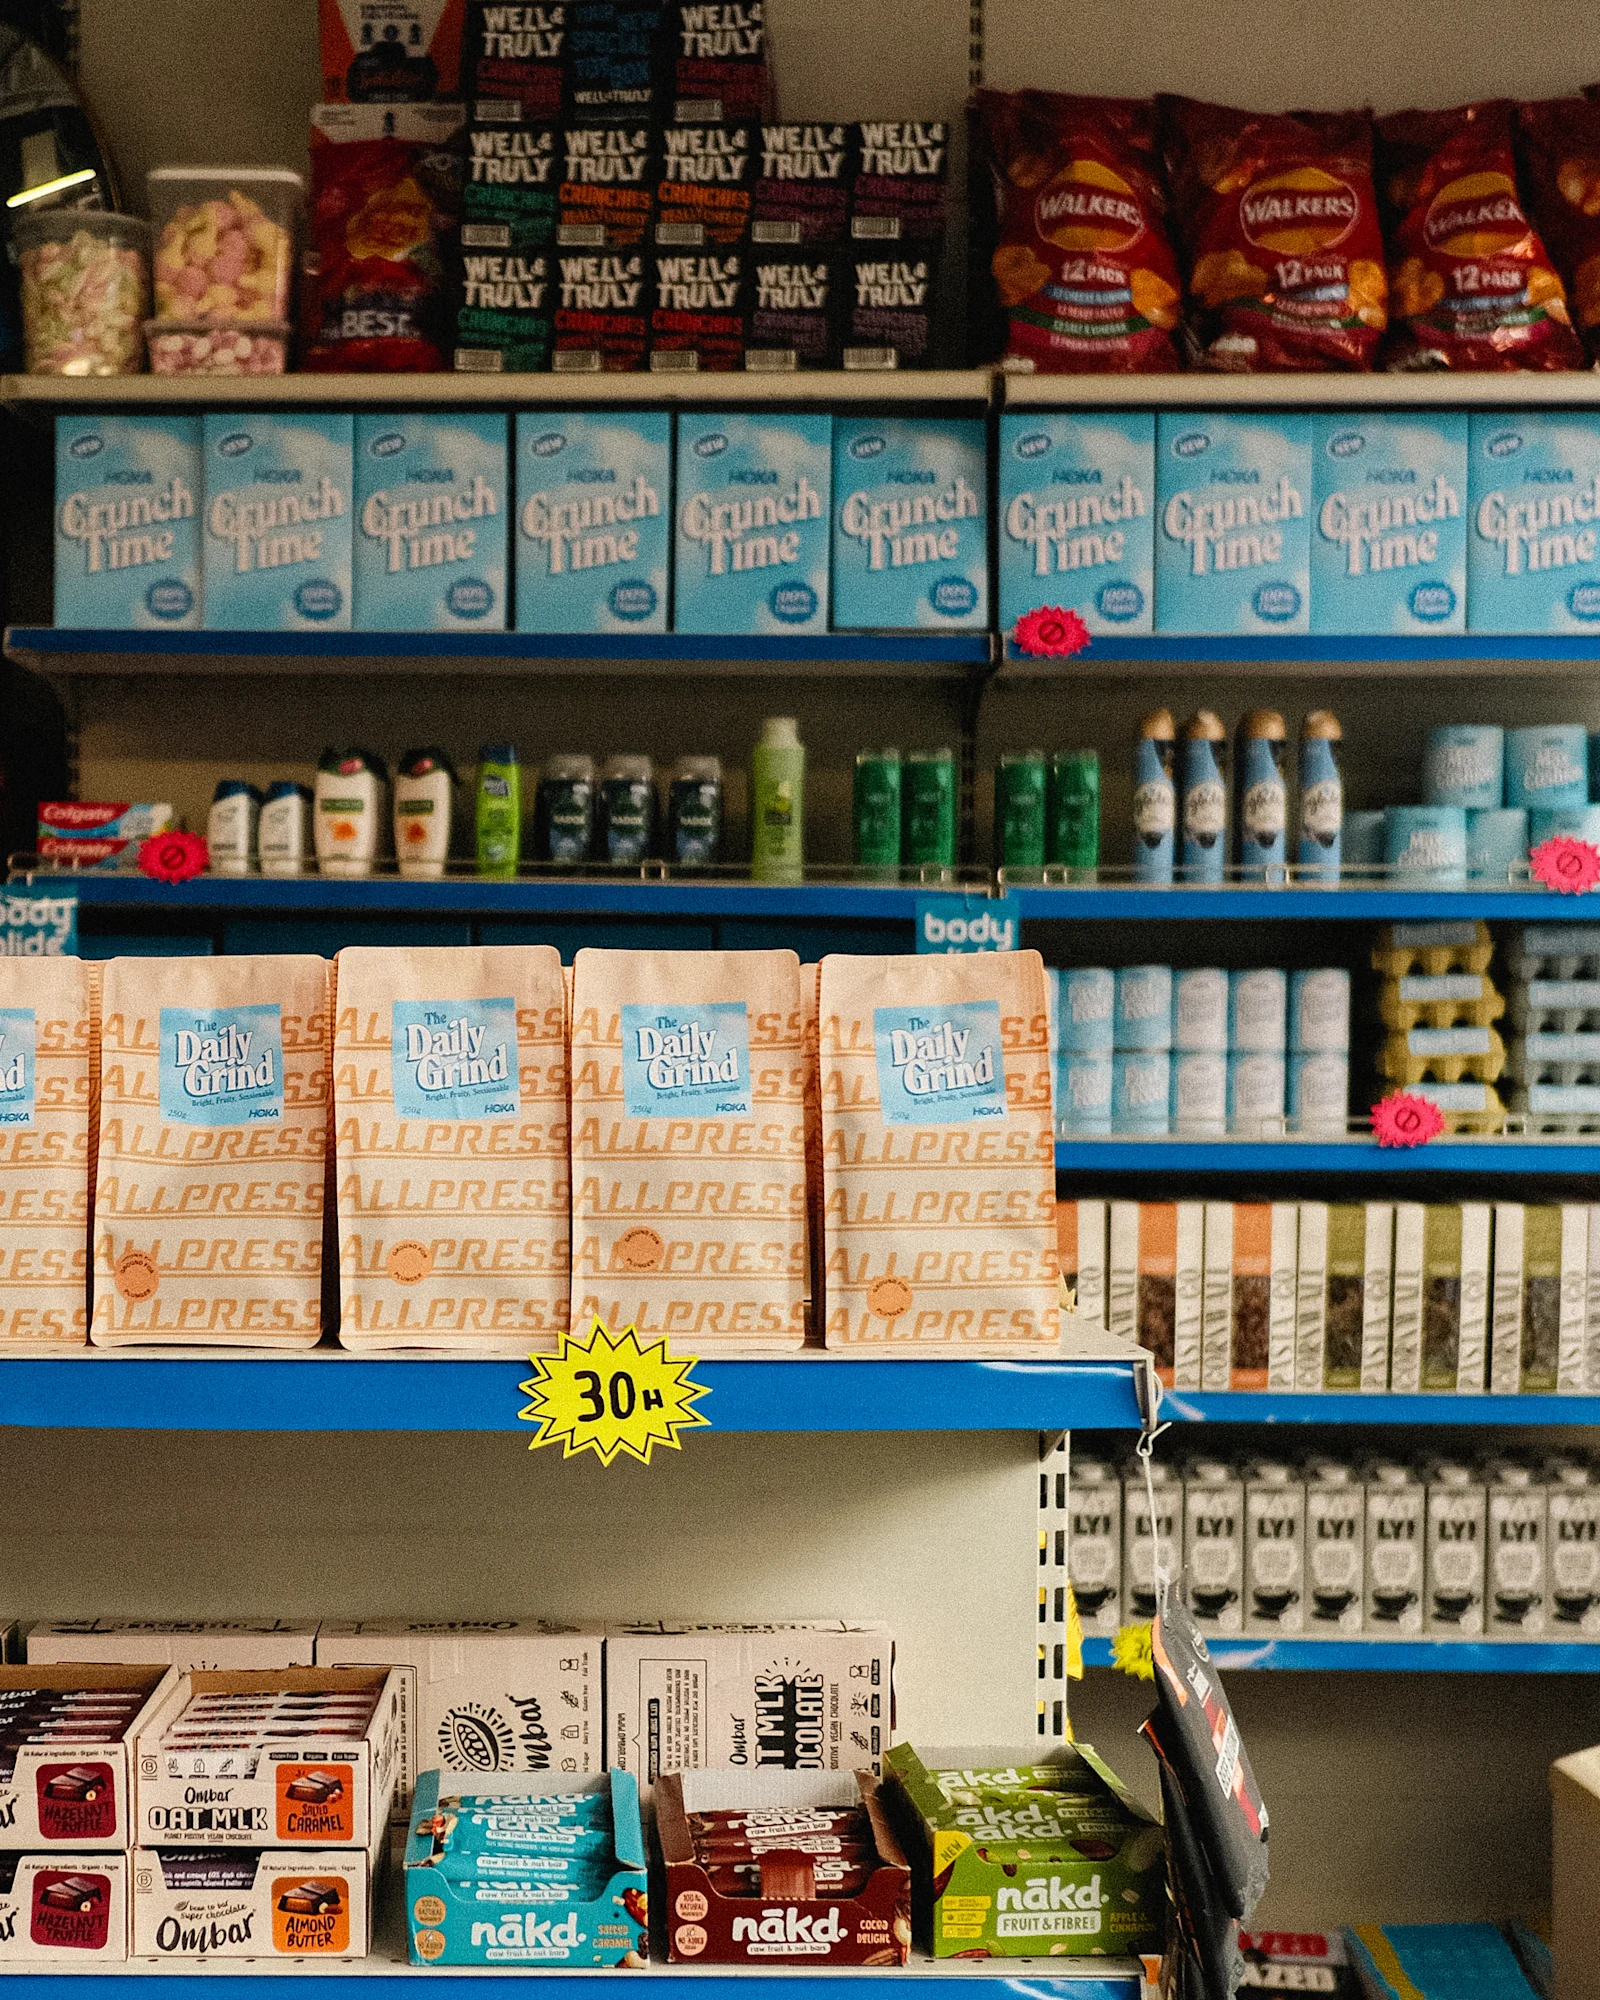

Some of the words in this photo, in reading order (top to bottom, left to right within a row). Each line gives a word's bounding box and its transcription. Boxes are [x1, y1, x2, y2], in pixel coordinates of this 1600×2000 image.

[482, 32, 563, 58] TRULY
[681, 31, 762, 58] TRULY
[470, 155, 552, 182] TRULY
[565, 154, 648, 182] TRULY
[665, 154, 748, 182] TRULY
[762, 151, 846, 179] TRULY
[861, 147, 944, 175] TRULY
[1040, 191, 1142, 229] WALKERS
[1243, 196, 1355, 224] WALKERS
[463, 281, 547, 308] TRULY
[560, 281, 642, 308] TRULY
[658, 281, 741, 309] TRULY
[756, 286, 828, 308] TRULY
[855, 284, 928, 307] TRULY
[341, 308, 411, 339] BEST
[61, 478, 193, 537] Crunch
[210, 477, 345, 537] Crunch
[362, 475, 497, 538] Crunch
[522, 476, 658, 539] Crunch
[684, 476, 821, 539] Crunch
[842, 478, 978, 535] Crunch
[1008, 475, 1145, 540] Crunch
[1165, 475, 1301, 540] Crunch
[83, 532, 175, 573] Time
[234, 531, 324, 573] Time
[388, 529, 476, 573] Time
[545, 529, 640, 574] Time
[707, 530, 801, 574] Time
[870, 528, 959, 570] Time
[1033, 530, 1125, 576] Time
[1188, 531, 1280, 576] Time
[924, 913, 1013, 950] body
[195, 1019, 217, 1033] The
[424, 1012, 447, 1026] The
[656, 1016, 678, 1029] The
[908, 1017, 930, 1031] The
[175, 1023, 253, 1067] Daily
[405, 1017, 487, 1062] Daily
[636, 1021, 718, 1063] Daily
[890, 1021, 971, 1067] Daily
[184, 1048, 275, 1097] Grind
[416, 1043, 509, 1092] Grind
[647, 1047, 740, 1092] Grind
[903, 1045, 995, 1097] Grind
[248, 1108, 280, 1119] HOKA
[484, 1103, 515, 1114] HOKA
[715, 1103, 747, 1112] HOKA
[973, 1107, 1003, 1116] HOKA
[824, 1128, 1055, 1165] ALLPRESS
[97, 1175, 325, 1214] ALLPRESS
[339, 1174, 570, 1212] ALLPRESS
[826, 1187, 1057, 1225] ALLPRESS
[341, 1293, 570, 1331] ALLPRESS
[574, 1370, 636, 1422] 30
[507, 1692, 552, 1771] mbar
[729, 1713, 749, 1766] Ombar
[185, 1786, 234, 1804] Ombar
[148, 1806, 206, 1831] OAT
[287, 1814, 345, 1833] CARAMEL
[940, 1840, 962, 1862] NEW
[156, 1911, 254, 1954] Ombar
[285, 1915, 337, 1934] ALMOND
[286, 1932, 335, 1949] BUTTER
[1003, 1918, 1040, 1931] FRUIT
[1042, 1918, 1053, 1930] &
[1054, 1917, 1089, 1930] FIBRE
